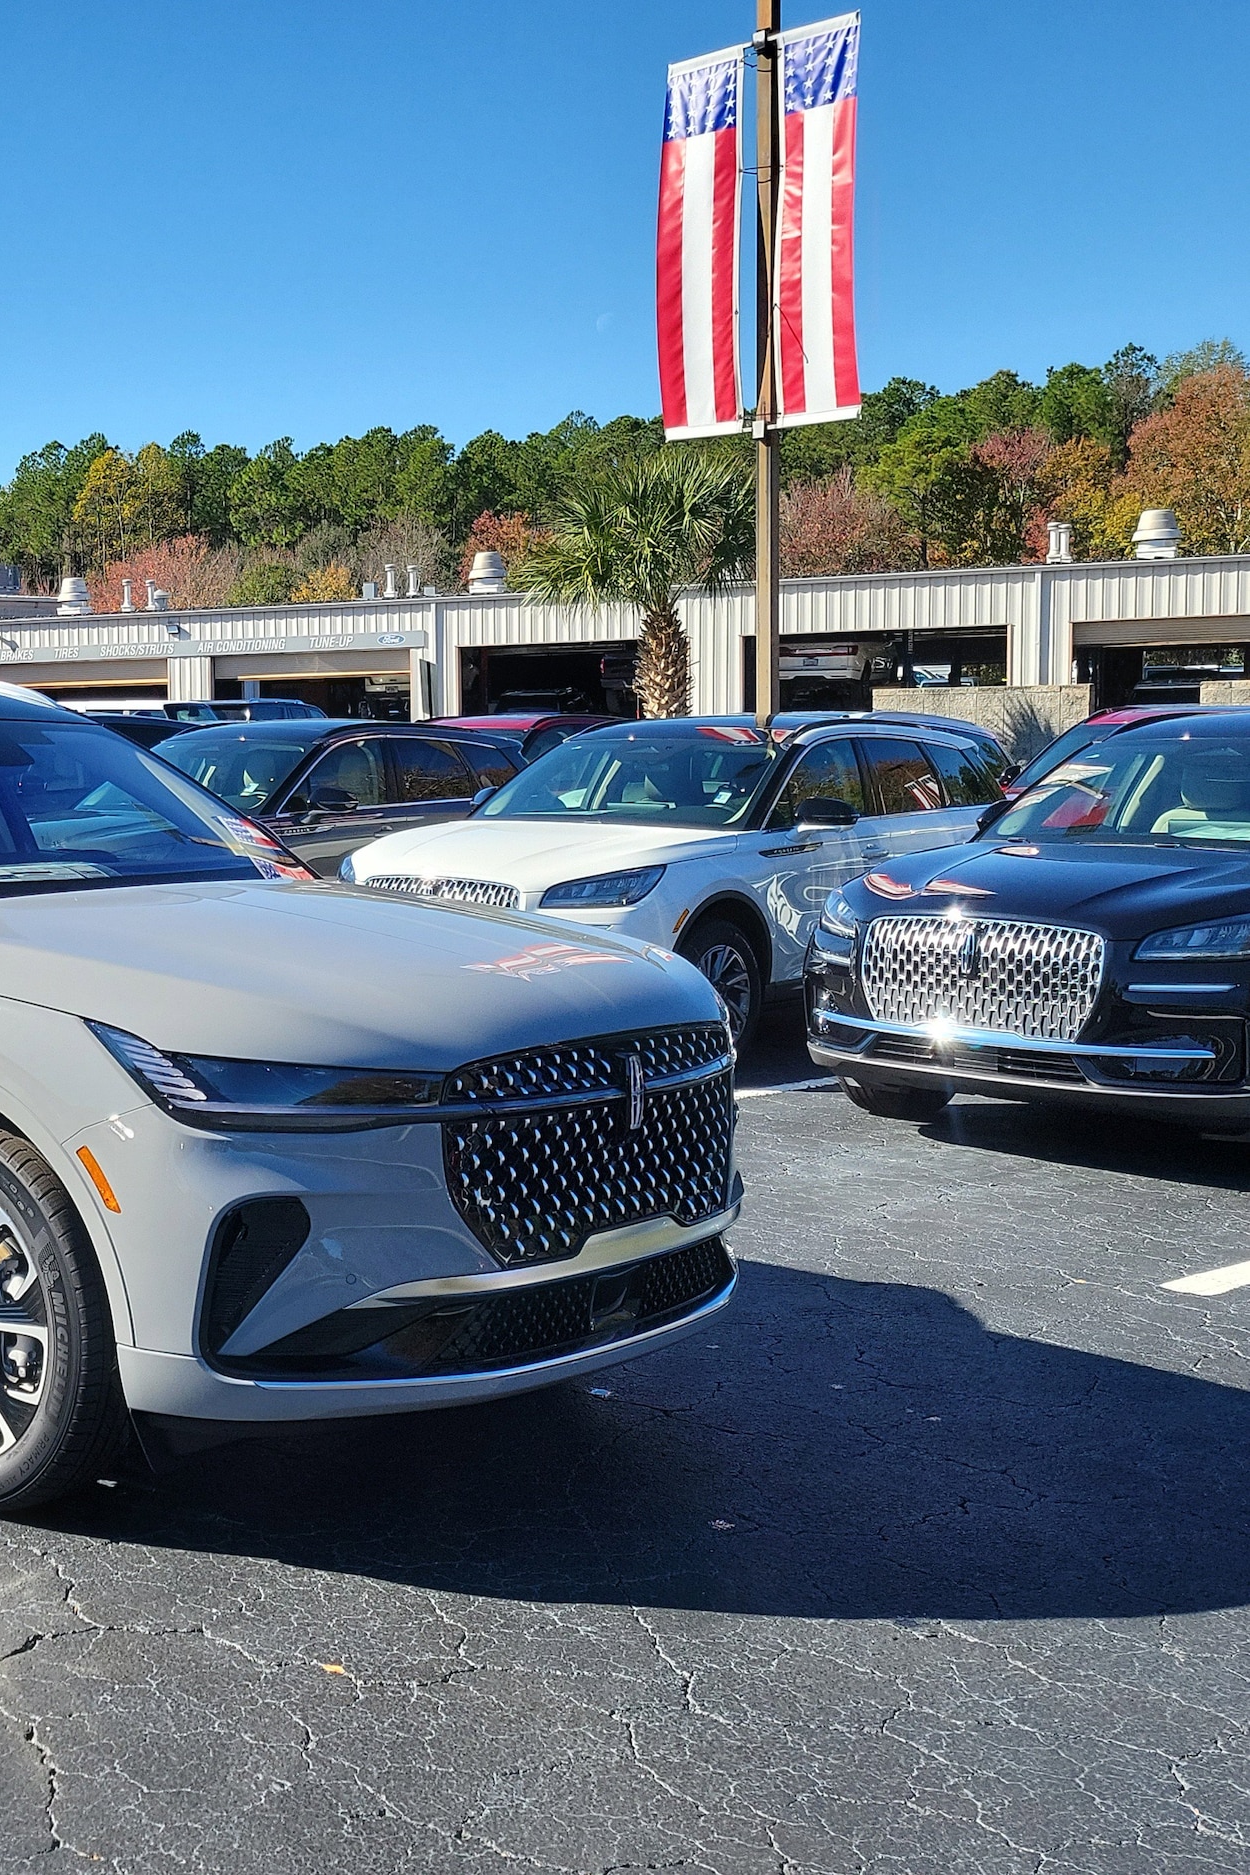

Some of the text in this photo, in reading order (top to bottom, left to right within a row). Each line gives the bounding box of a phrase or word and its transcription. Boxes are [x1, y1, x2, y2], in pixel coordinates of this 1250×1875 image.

[197, 638, 286, 653] AIR CONDITIONING
[309, 635, 354, 649] TUNE-UP
[0, 650, 34, 661] BRAKES
[54, 647, 79, 659] TIRES
[100, 643, 175, 657] SHOCKS/STRUTS
[48, 1291, 69, 1416] MICHELIN
[19, 1432, 50, 1474] PRIMACY
